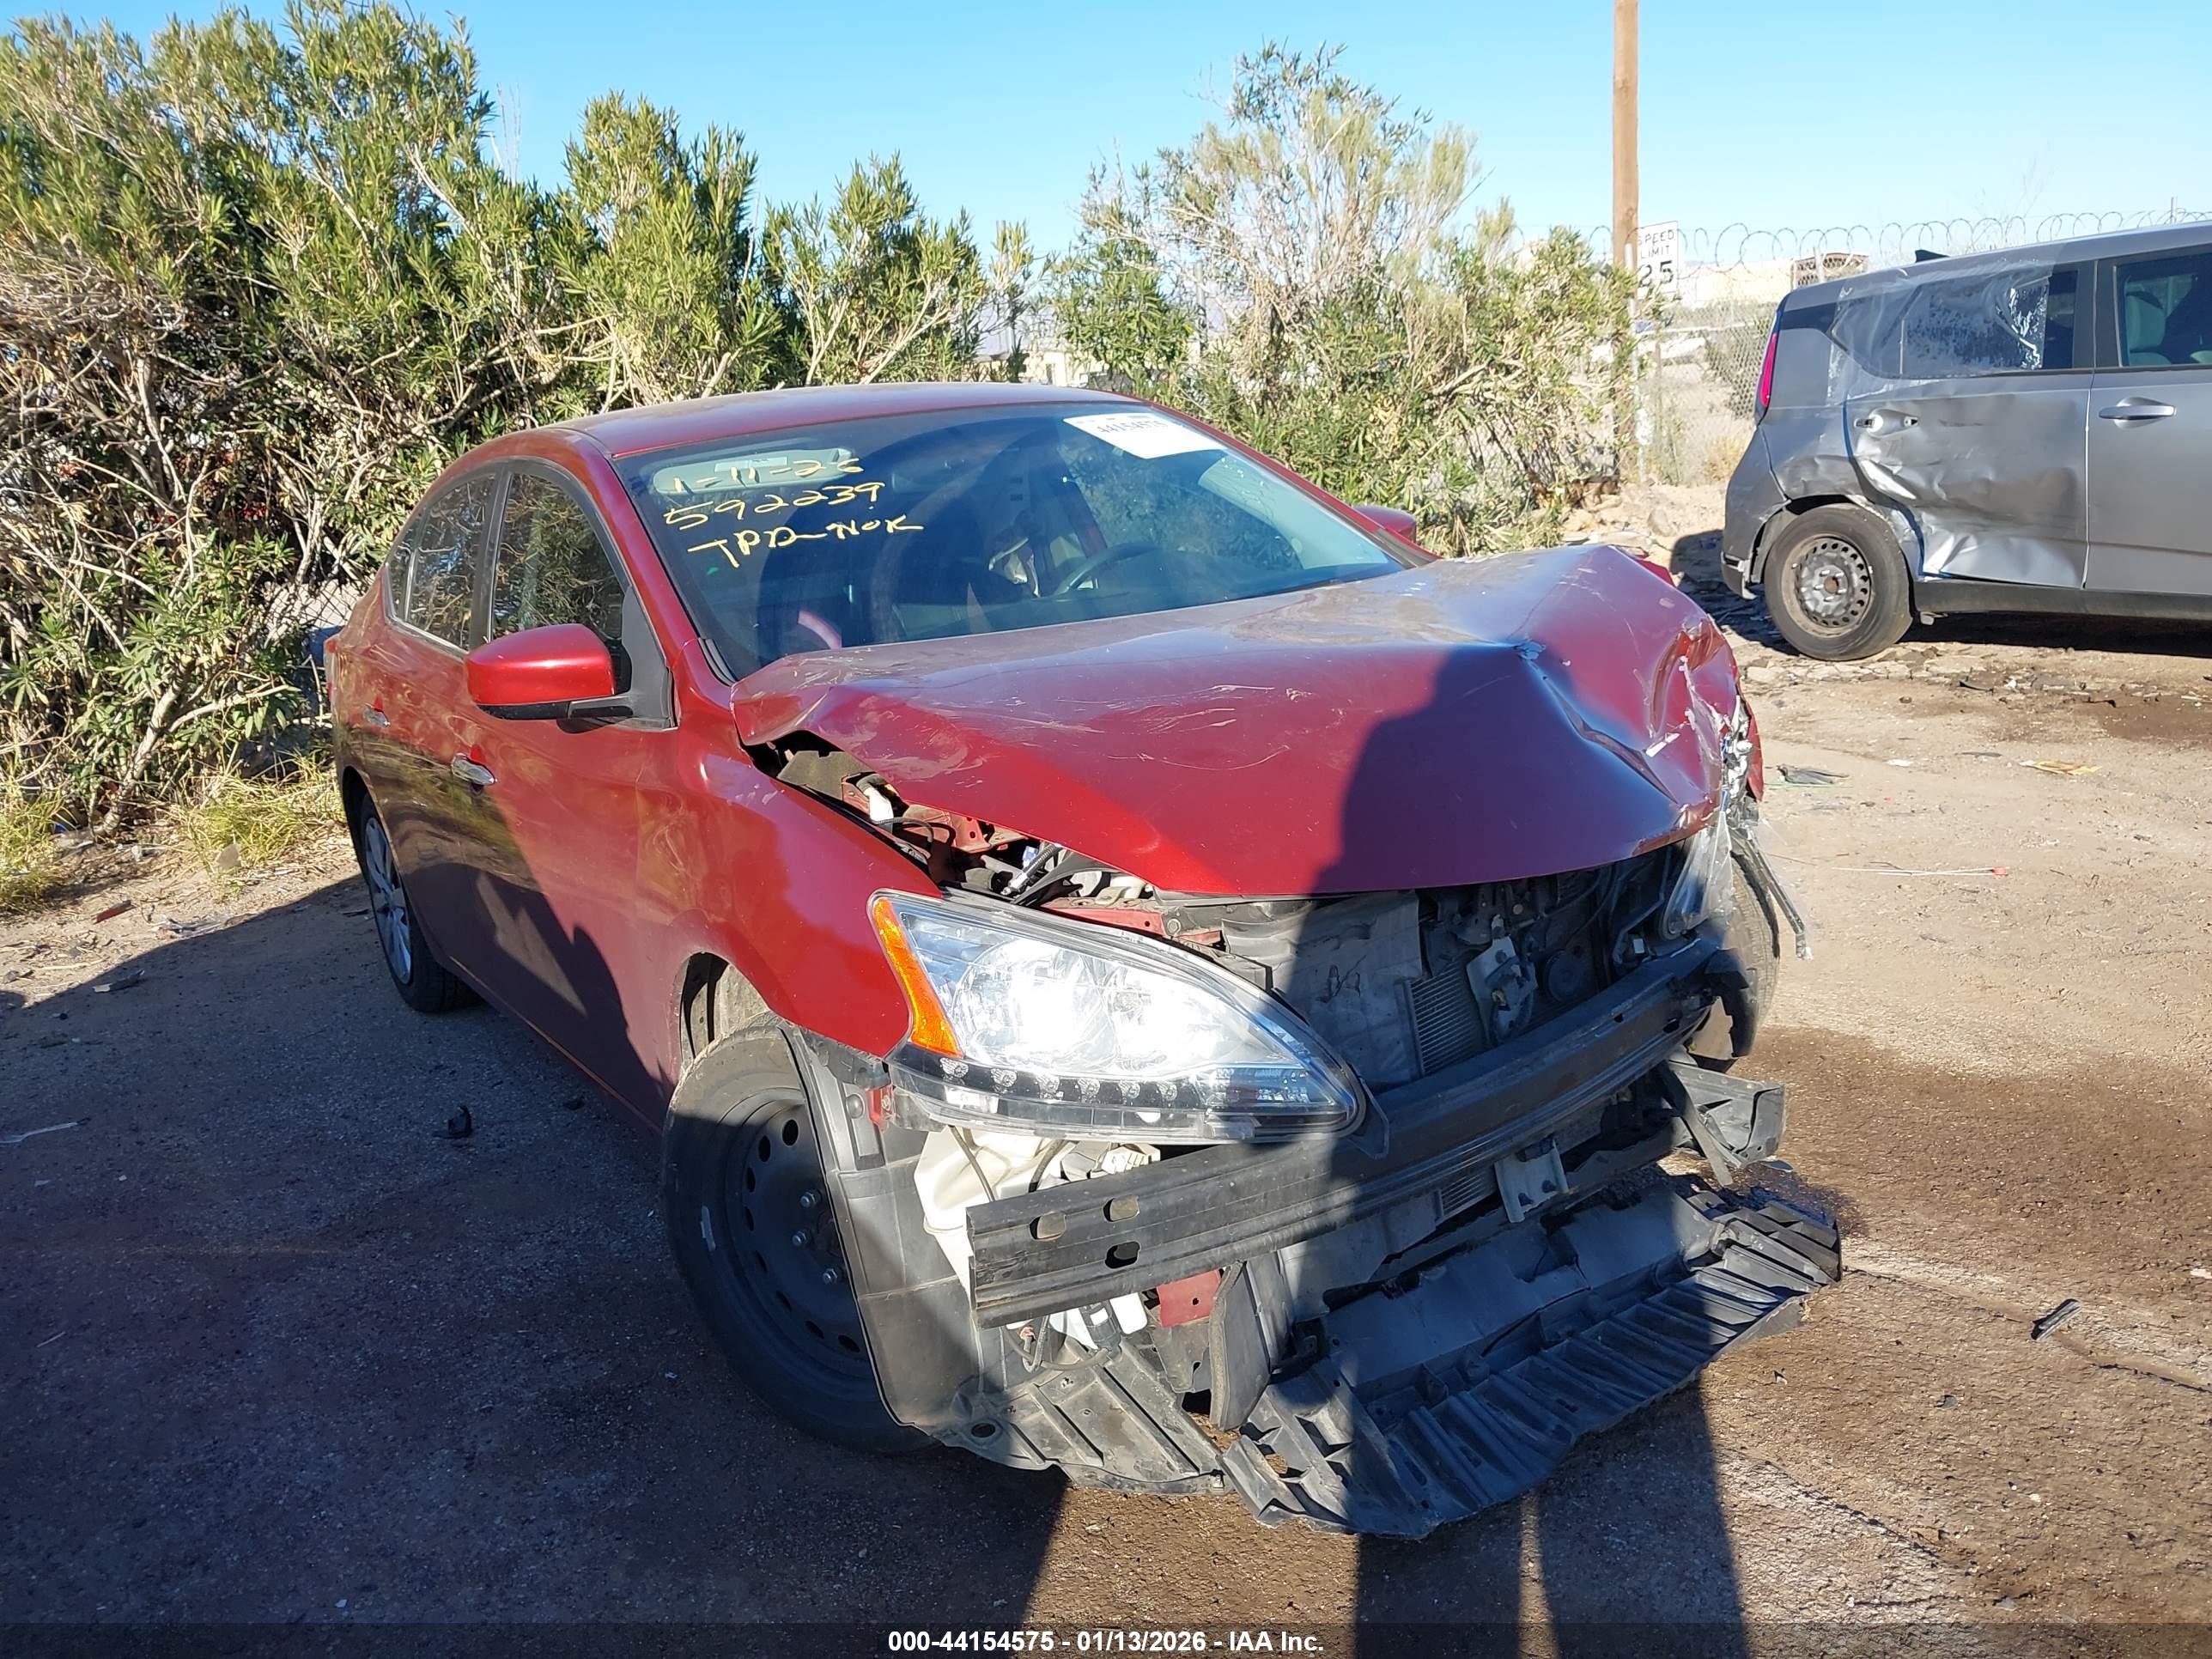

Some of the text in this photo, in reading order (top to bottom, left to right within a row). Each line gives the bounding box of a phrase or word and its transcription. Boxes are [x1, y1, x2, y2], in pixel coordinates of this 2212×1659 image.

[1638, 229, 1674, 246] SPEED
[1640, 245, 1670, 258] LIMIT
[1638, 260, 1674, 288] 25
[663, 482, 885, 530] 592239
